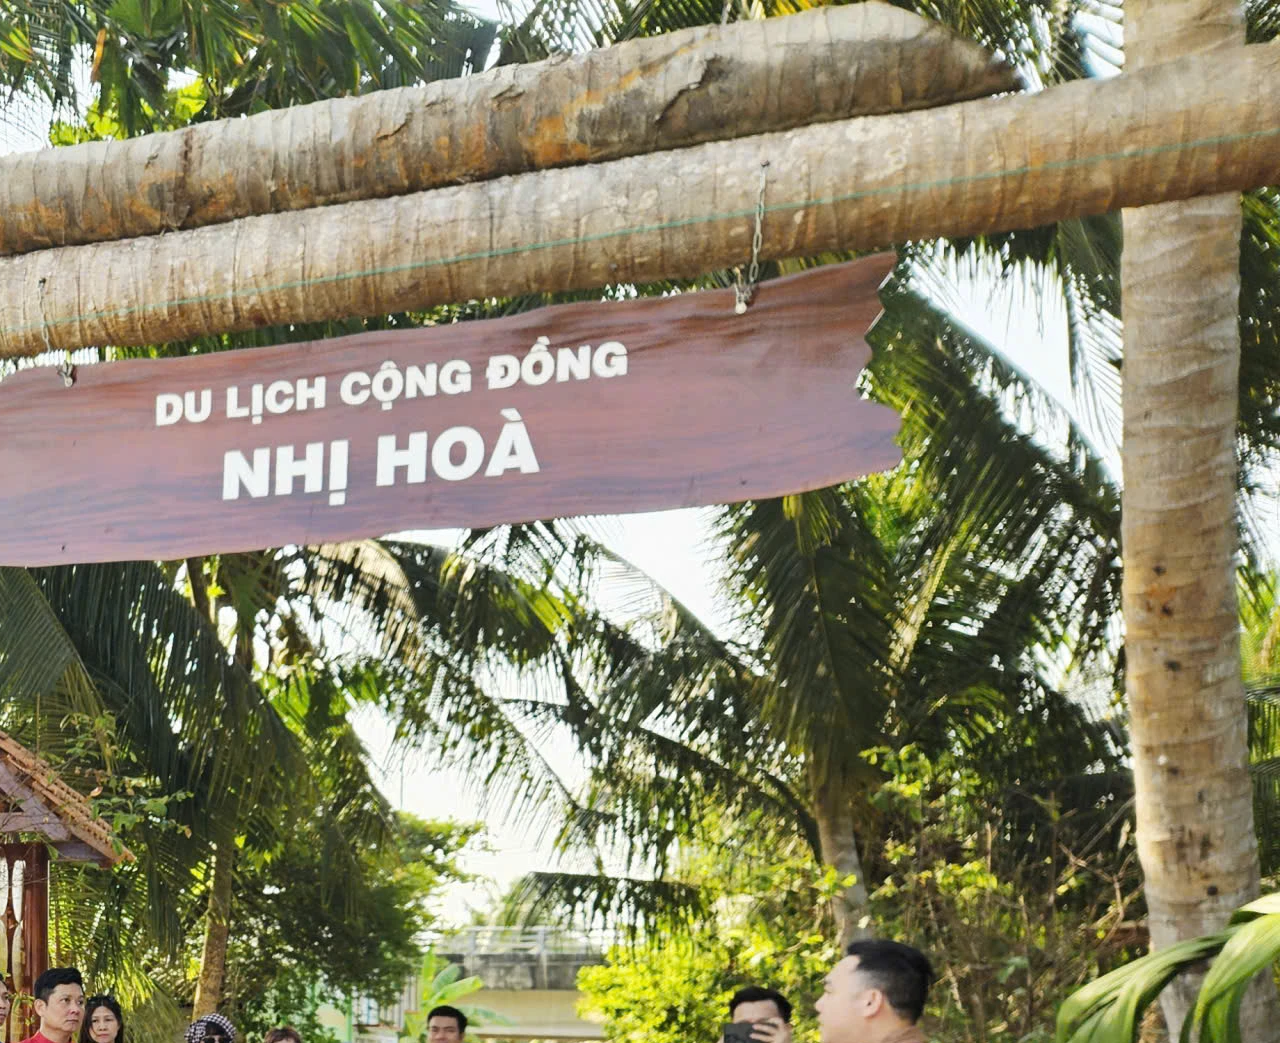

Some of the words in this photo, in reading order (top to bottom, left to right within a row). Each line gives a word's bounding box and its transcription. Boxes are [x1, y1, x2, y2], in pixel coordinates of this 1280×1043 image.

[155, 386, 213, 426] DU
[226, 376, 327, 425] LỊCH
[339, 359, 472, 412] CỘNG
[485, 335, 628, 393] ĐỒNG
[222, 440, 350, 507] NHỊ
[375, 407, 540, 488] HOÀ
